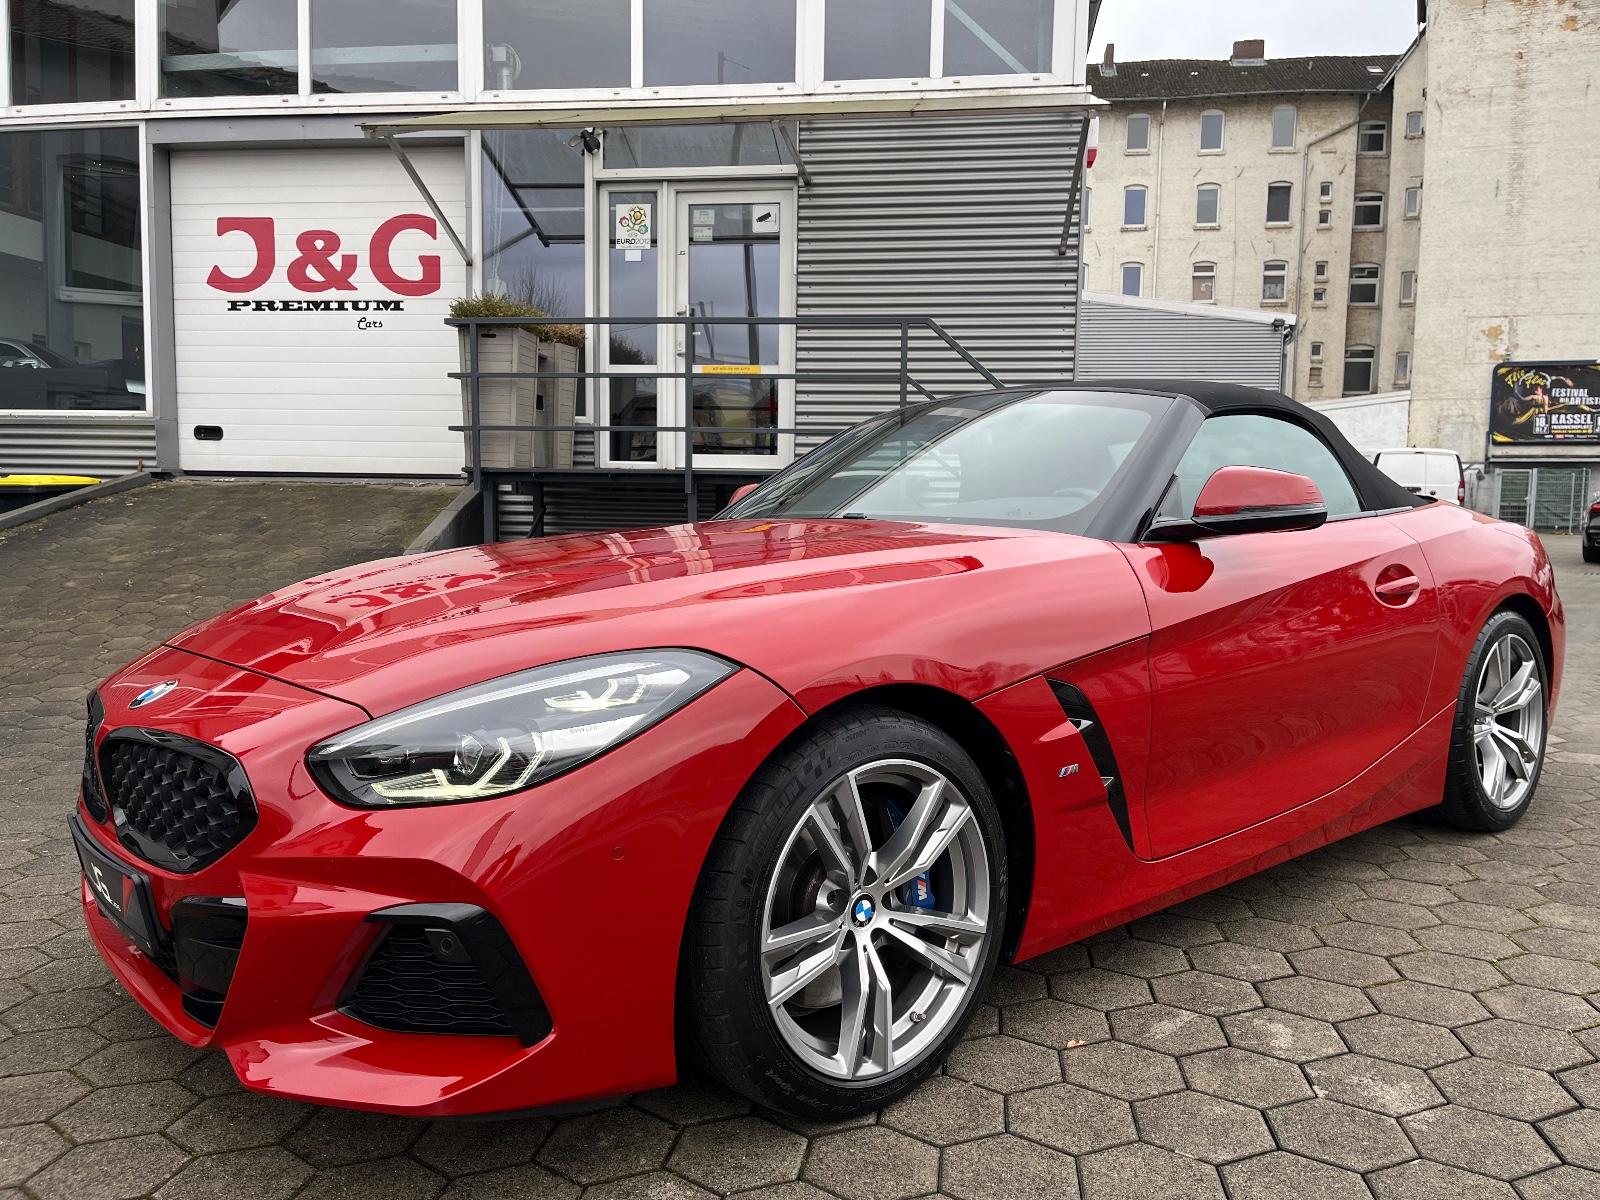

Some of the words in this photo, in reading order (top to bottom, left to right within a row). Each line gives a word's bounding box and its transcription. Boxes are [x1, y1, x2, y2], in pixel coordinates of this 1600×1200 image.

[207, 213, 441, 297] J&G
[226, 300, 405, 312] PREMIUM
[356, 317, 383, 330] Cars
[1551, 388, 1589, 398] FESTIVAL
[1551, 414, 1593, 424] KASSEL
[764, 1069, 796, 1096] Sport
